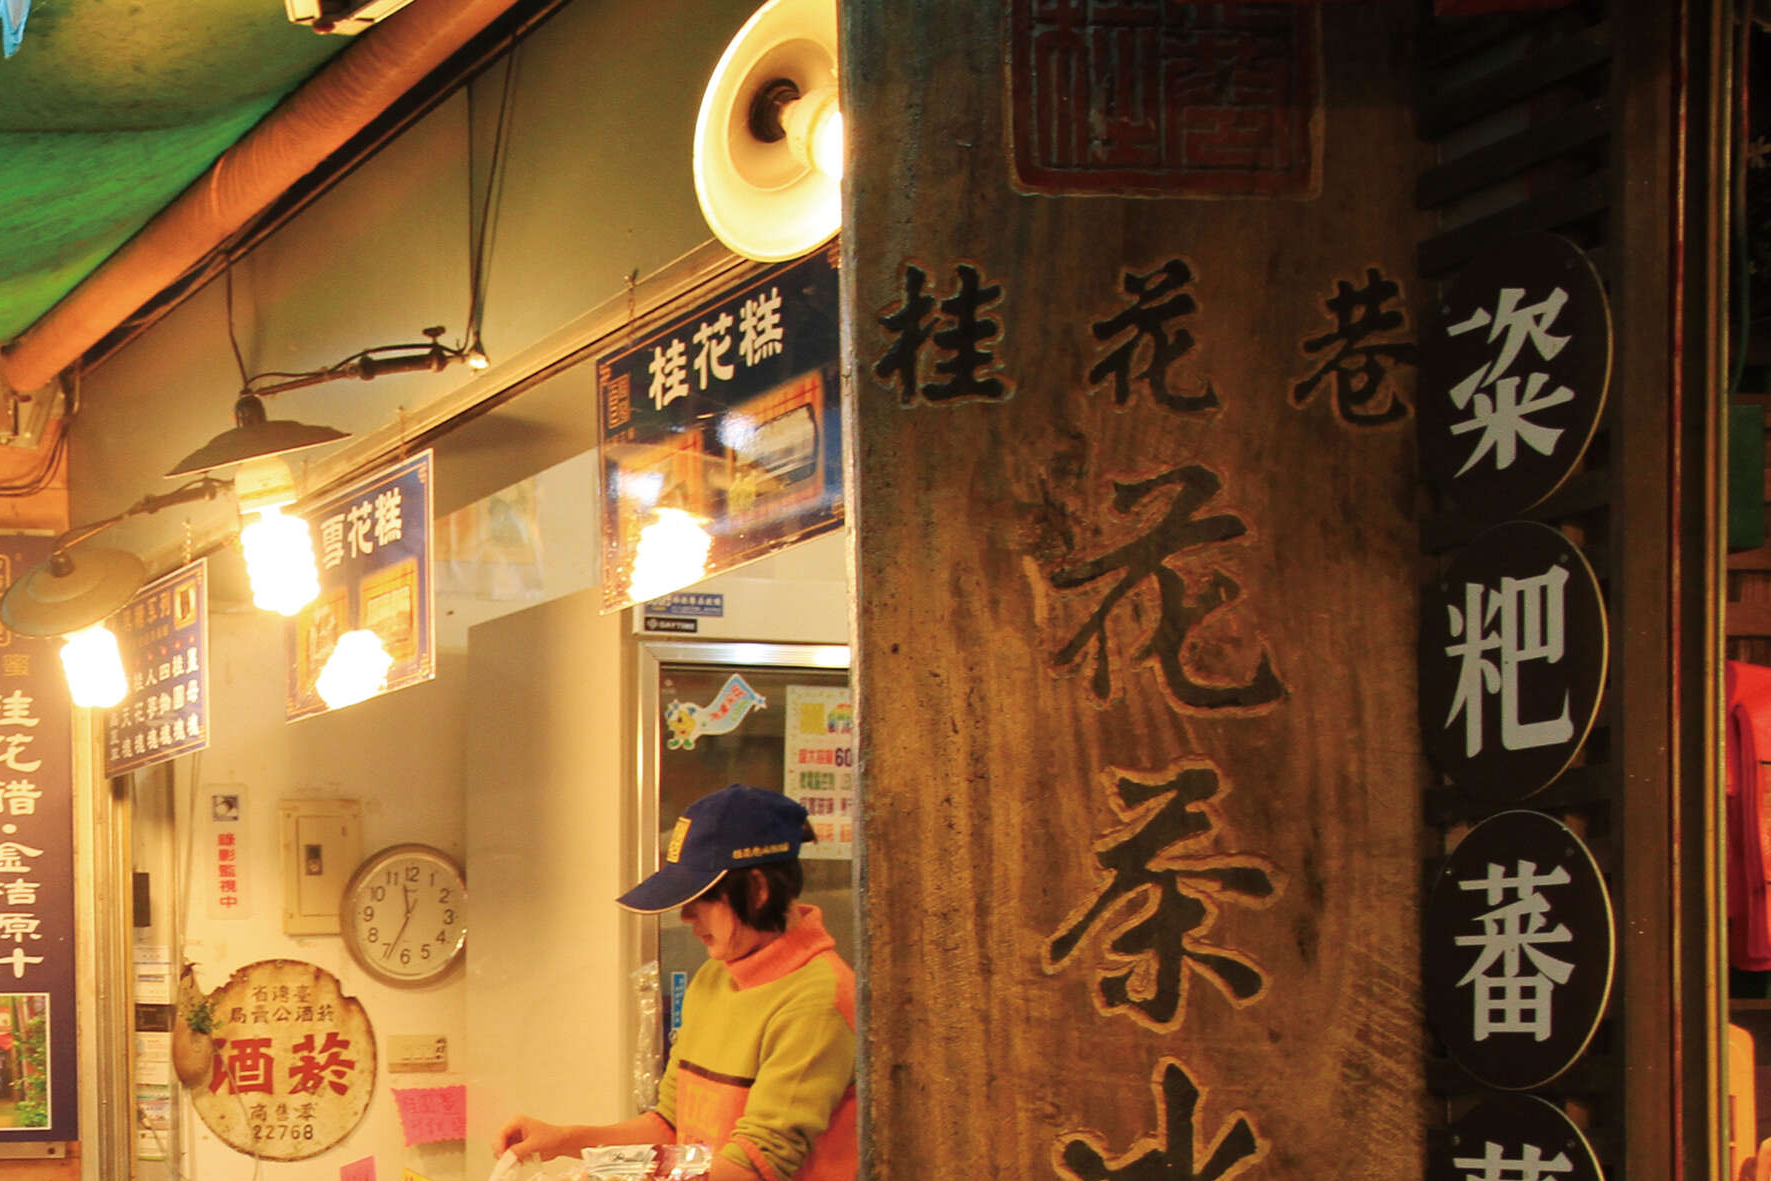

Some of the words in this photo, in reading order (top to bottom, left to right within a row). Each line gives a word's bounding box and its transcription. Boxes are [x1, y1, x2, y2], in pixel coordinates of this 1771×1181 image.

[649, 287, 784, 410] 桂花糕
[321, 487, 403, 569] 雪花糕
[386, 871, 399, 886] 11
[405, 866, 420, 883] 12
[371, 885, 386, 902] 10
[439, 887, 450, 904] 2
[363, 905, 374, 922] 9
[443, 908, 454, 925] 3
[368, 926, 379, 943] 8
[435, 929, 446, 944] 4
[382, 942, 392, 959] 7
[400, 948, 411, 965] 6
[420, 943, 432, 960] 5
[252, 1123, 315, 1141] 22768
